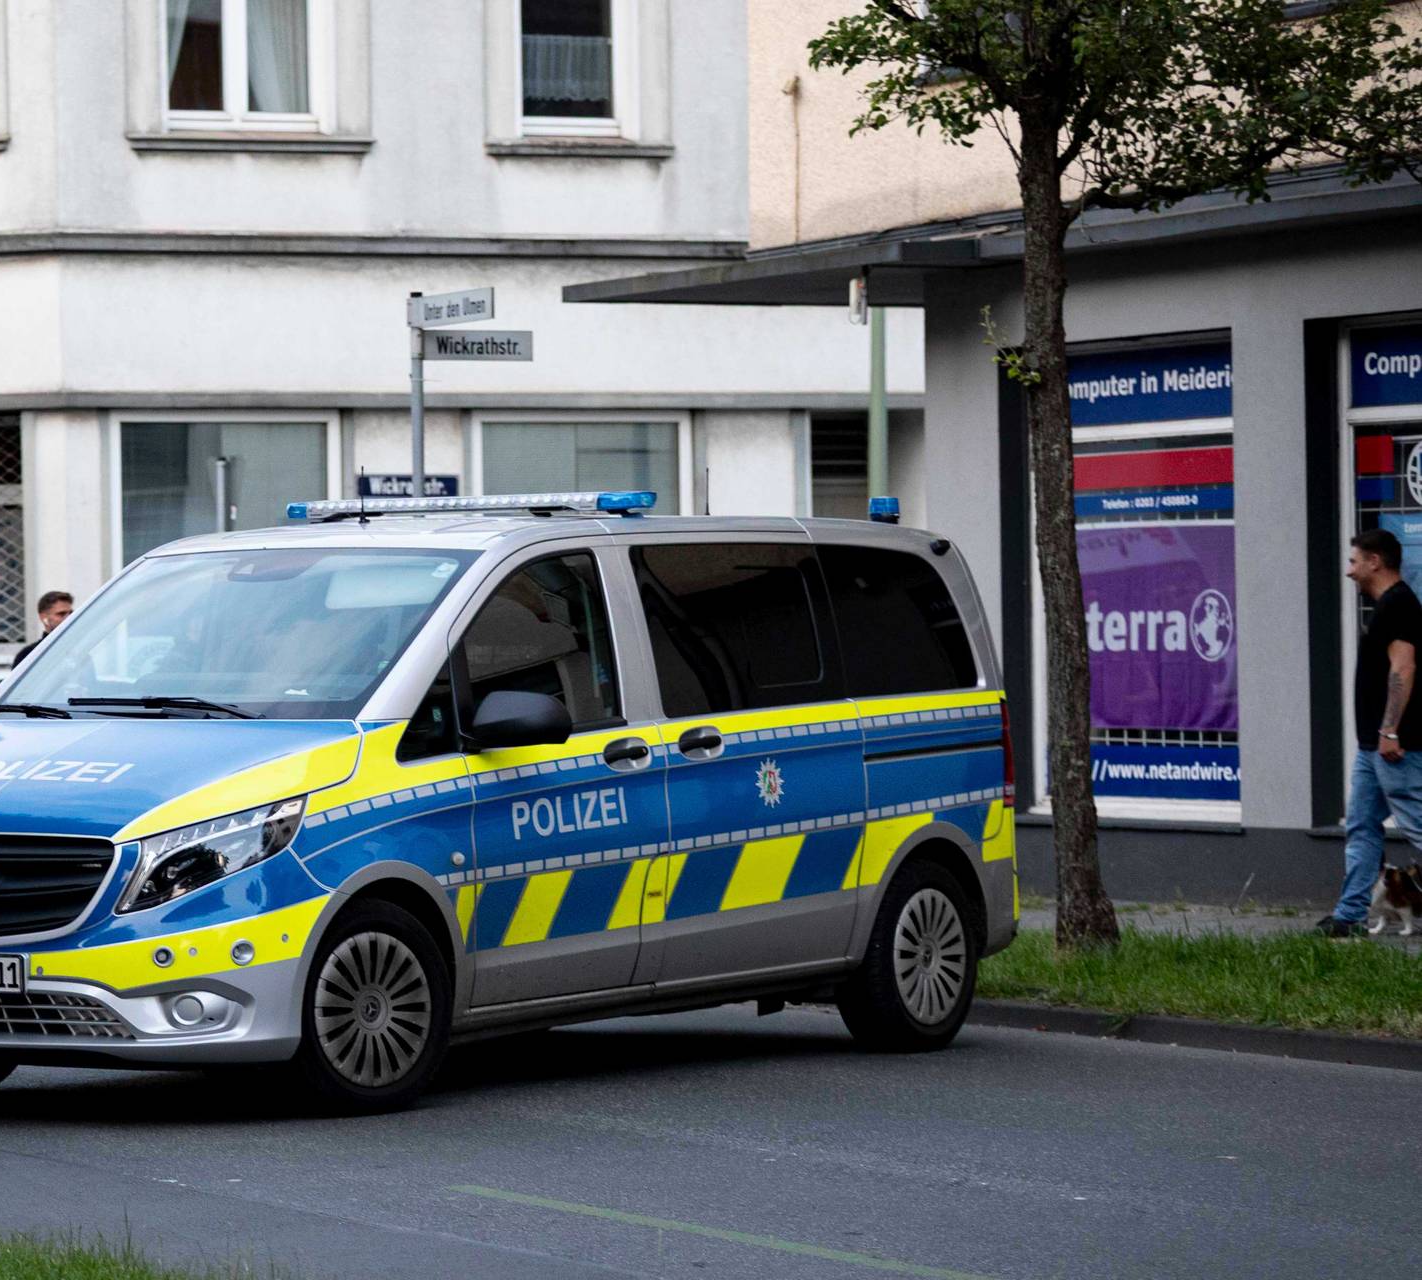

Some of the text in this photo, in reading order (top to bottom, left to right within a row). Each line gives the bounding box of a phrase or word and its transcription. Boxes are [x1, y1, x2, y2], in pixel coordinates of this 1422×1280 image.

[423, 297, 486, 321] Unter den Ulmen
[436, 335, 522, 356] Wickrathstr.
[1068, 364, 1234, 404] omputer in Meideri
[369, 477, 448, 495] Wickrastr.
[1085, 601, 1187, 652] terra
[512, 786, 628, 841] POLIZEI
